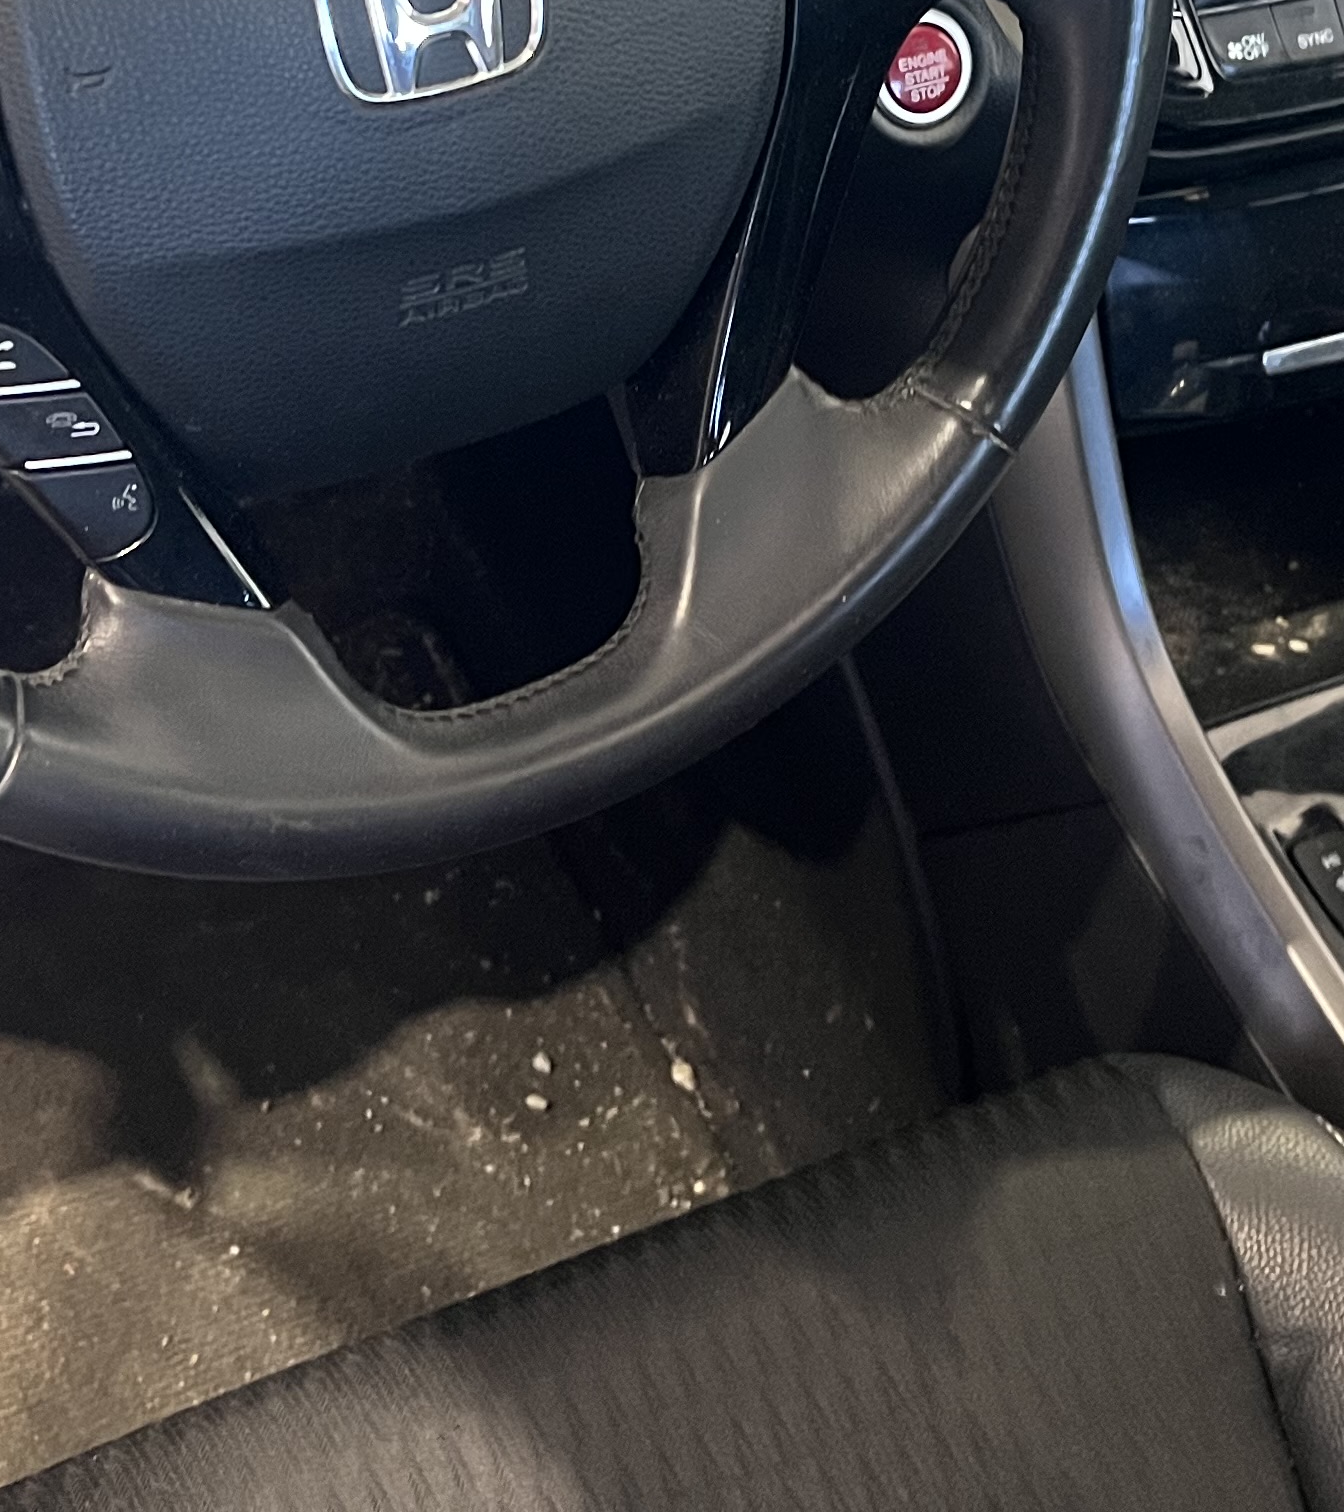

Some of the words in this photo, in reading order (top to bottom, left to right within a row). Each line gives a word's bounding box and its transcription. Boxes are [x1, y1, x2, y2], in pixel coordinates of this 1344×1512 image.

[1297, 27, 1334, 50] SYNC
[898, 48, 947, 73] ENGINE
[904, 64, 946, 86] START
[910, 83, 946, 103] STOP
